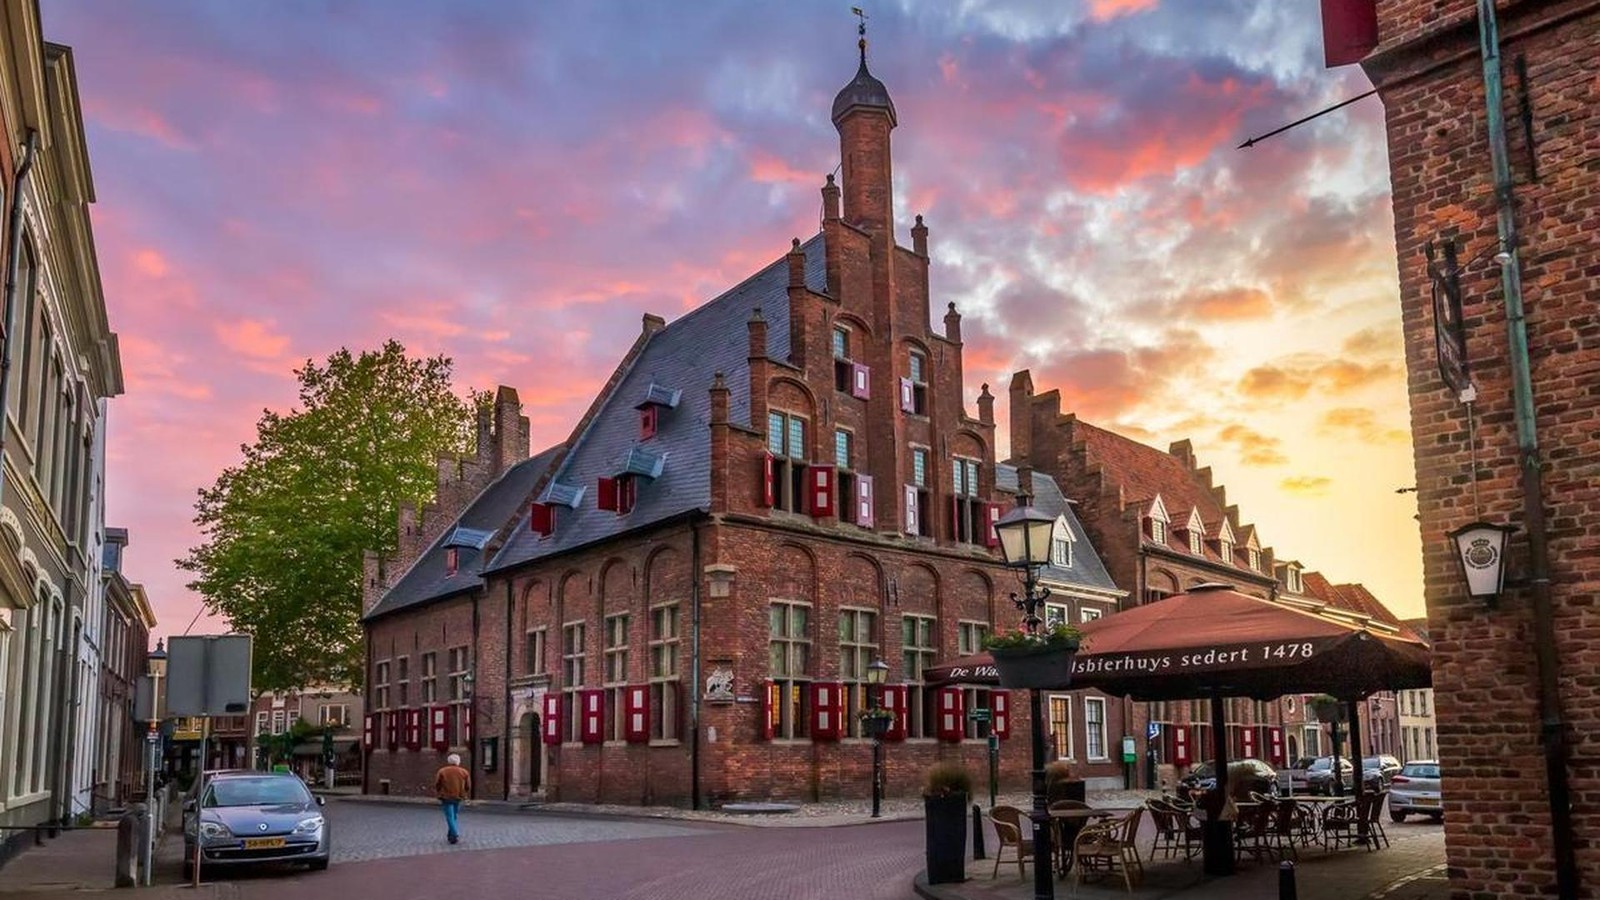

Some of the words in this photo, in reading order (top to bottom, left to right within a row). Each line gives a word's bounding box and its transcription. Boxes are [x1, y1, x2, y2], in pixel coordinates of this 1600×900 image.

[1181, 647, 1249, 667] sedert
[1263, 642, 1314, 660] 1478
[950, 667, 969, 678] De
[974, 665, 999, 677] Wa
